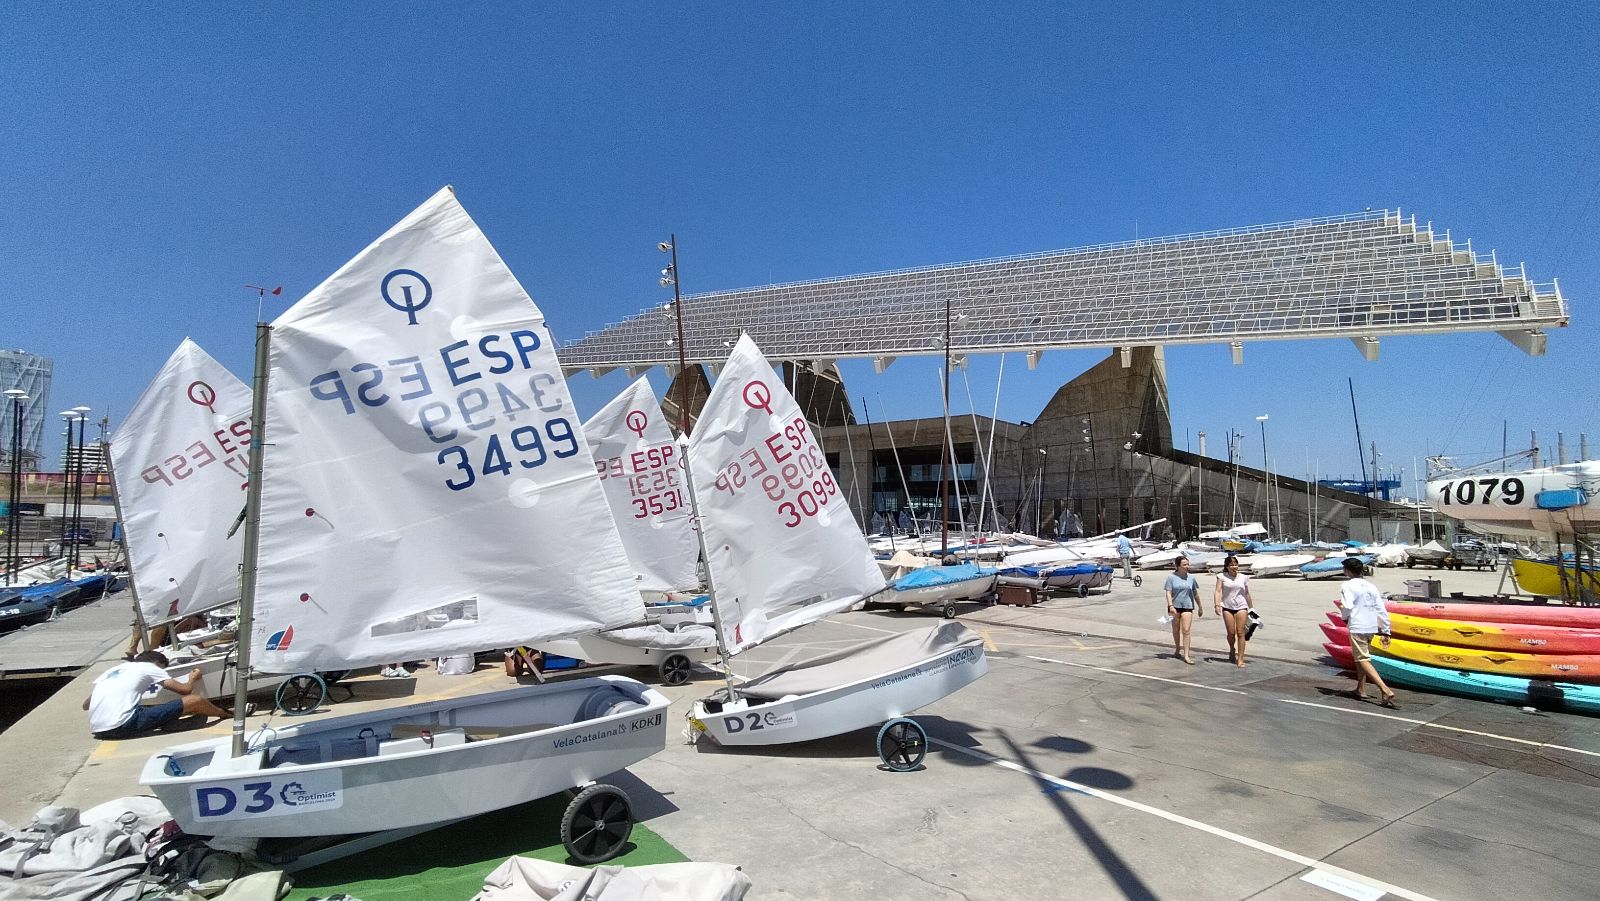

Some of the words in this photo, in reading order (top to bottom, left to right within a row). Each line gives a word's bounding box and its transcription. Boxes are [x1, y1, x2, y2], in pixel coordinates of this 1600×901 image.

[440, 329, 541, 387] ESP
[213, 420, 252, 454] ES
[764, 417, 807, 463] ESP
[437, 417, 579, 492] 3499
[631, 445, 674, 473] ESP
[632, 489, 683, 519] 3531
[777, 471, 836, 528] 3099
[1439, 477, 1525, 506] 1079
[552, 729, 618, 749] VelaCatalana
[723, 712, 765, 734] D2
[196, 781, 275, 817] D3
[297, 791, 336, 802] Optimist
